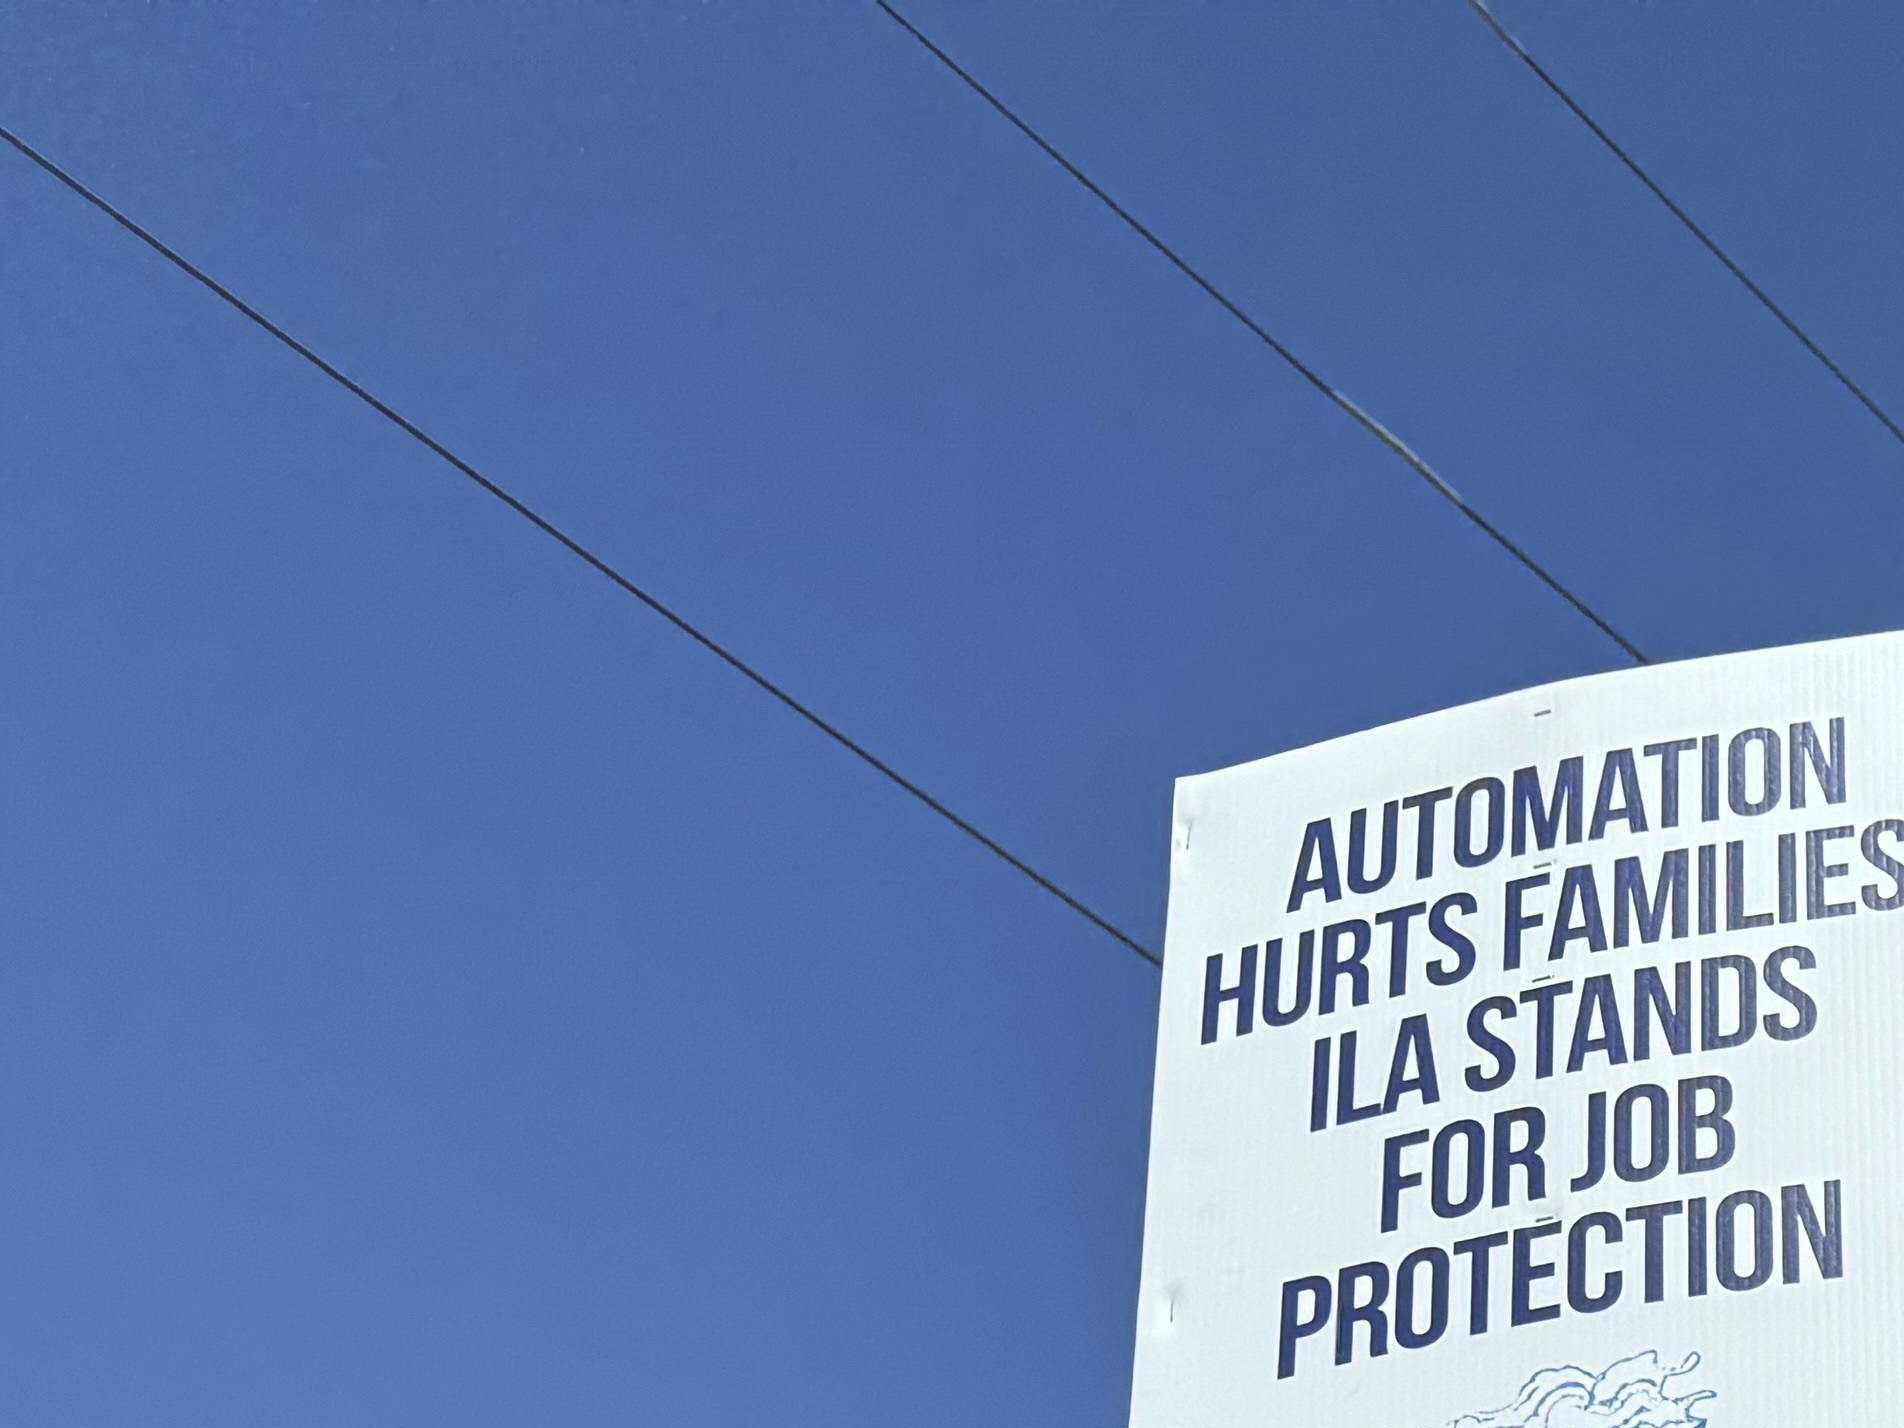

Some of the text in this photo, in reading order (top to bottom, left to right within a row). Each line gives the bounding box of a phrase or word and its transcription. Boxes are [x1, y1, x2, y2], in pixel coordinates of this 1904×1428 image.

[1286, 716, 1848, 914] AUTOMATION
[1201, 892, 1478, 1046] HURTS
[1310, 945, 1818, 1133] ILA STANDS
[1380, 1075, 1735, 1233] FOR JOB
[1276, 1179, 1844, 1380] PROTECTION
